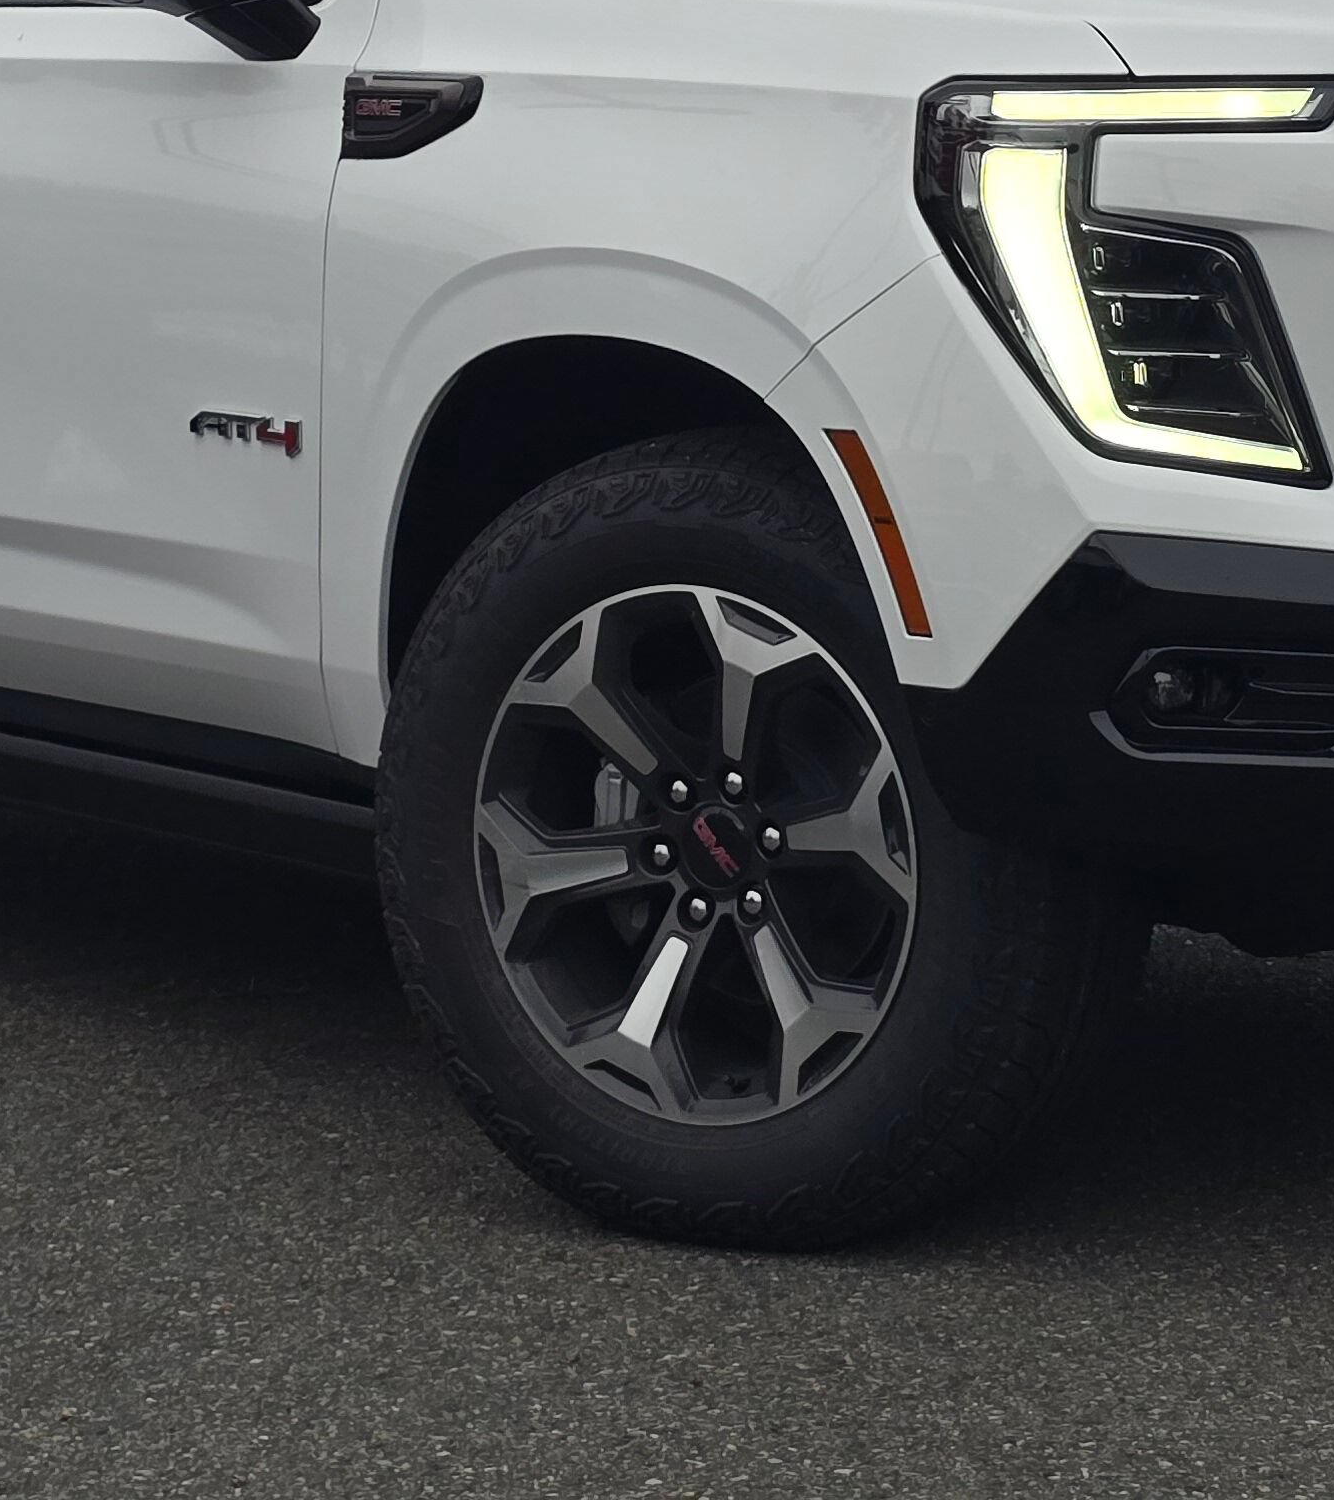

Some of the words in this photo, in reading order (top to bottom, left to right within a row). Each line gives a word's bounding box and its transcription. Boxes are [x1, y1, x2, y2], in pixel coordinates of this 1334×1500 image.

[355, 98, 403, 116] GMC
[189, 409, 303, 459] AT4
[692, 815, 740, 879] GMC
